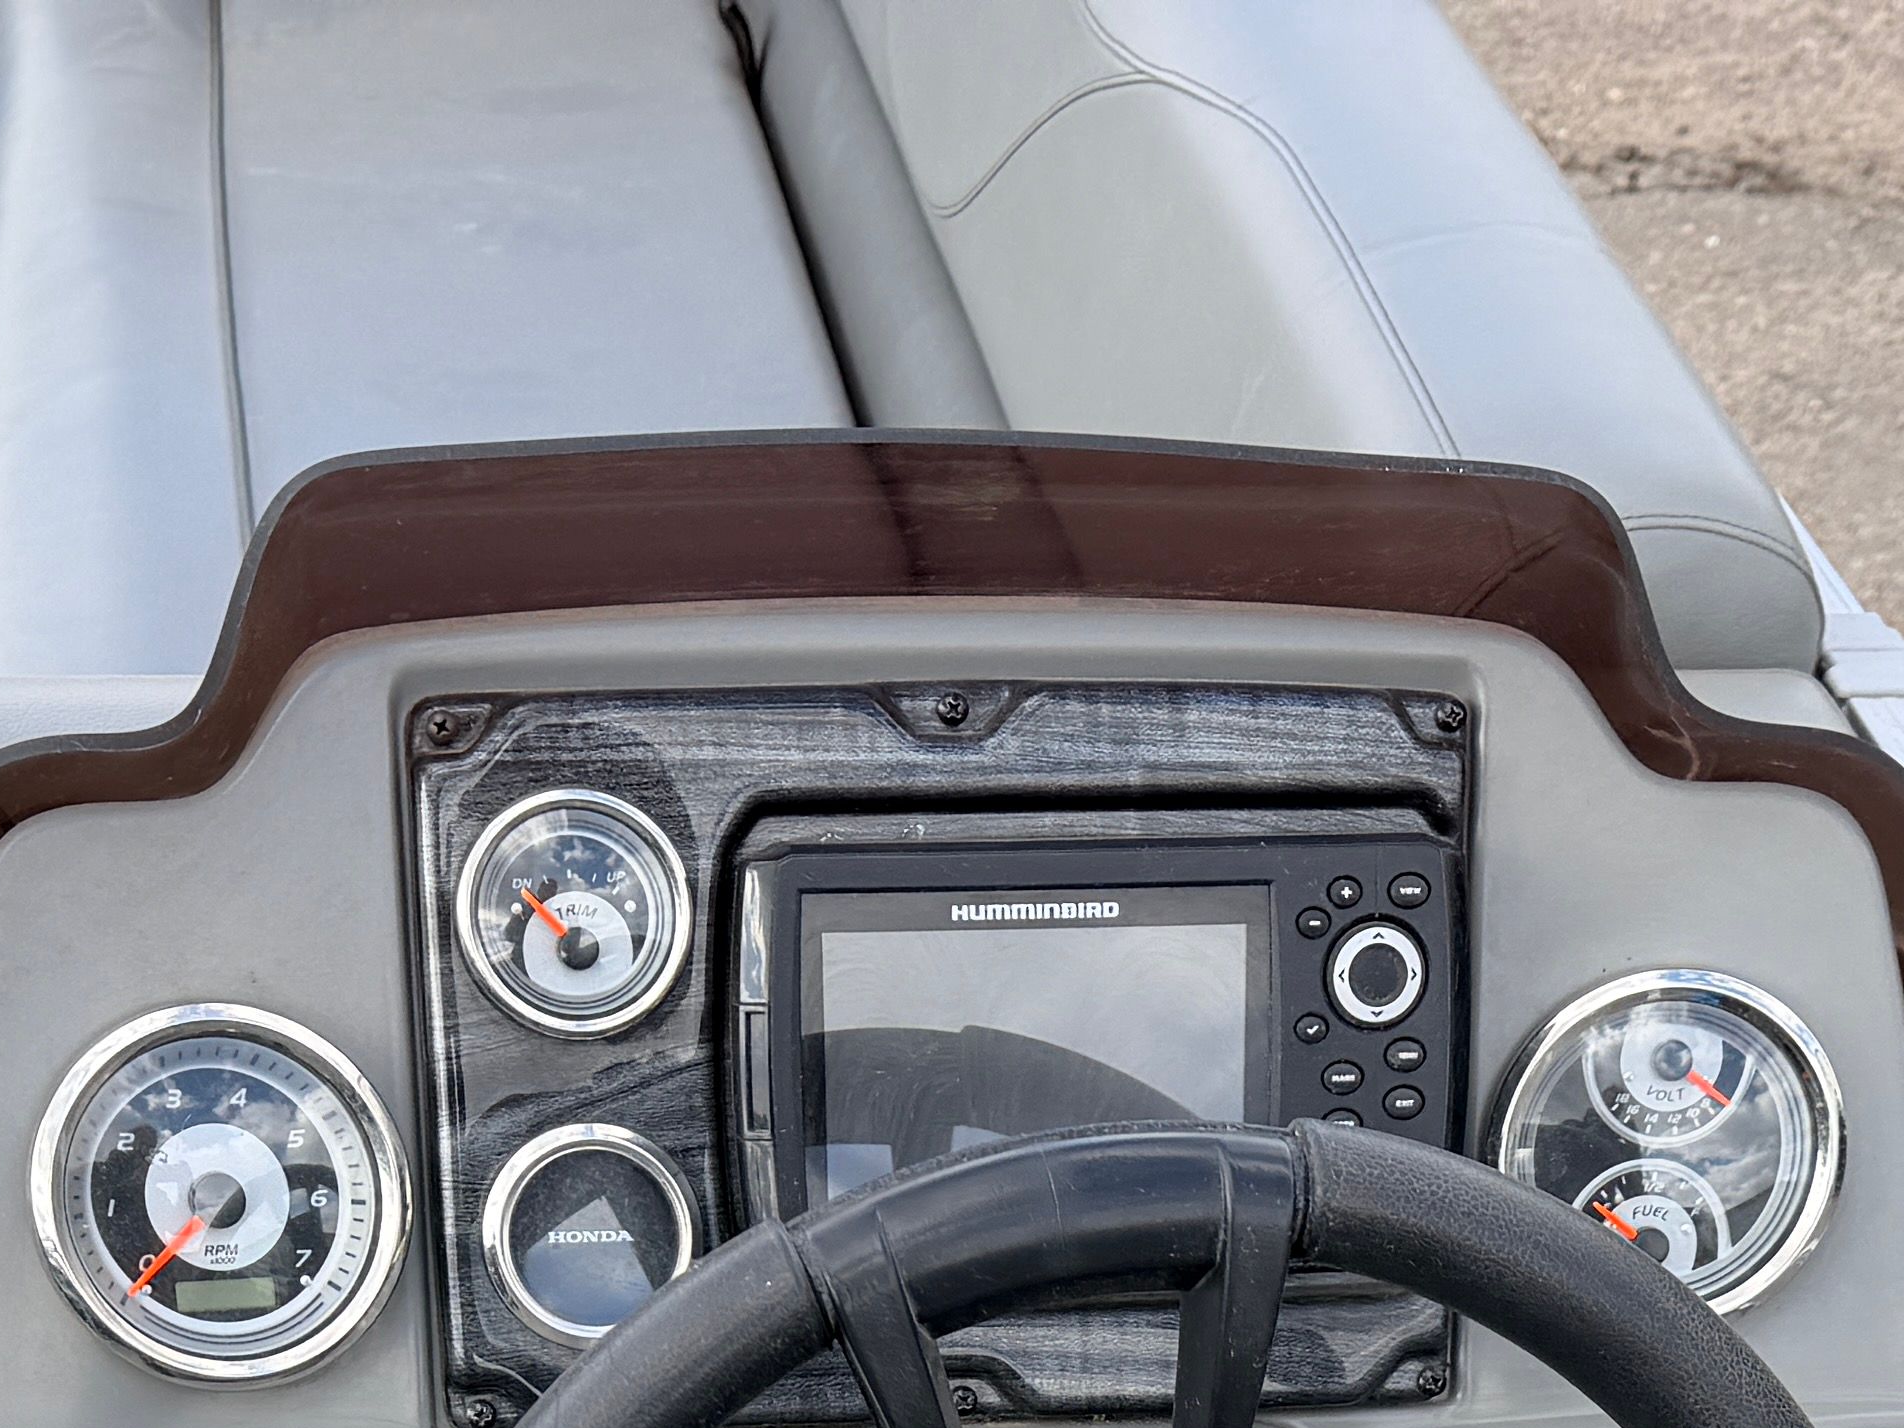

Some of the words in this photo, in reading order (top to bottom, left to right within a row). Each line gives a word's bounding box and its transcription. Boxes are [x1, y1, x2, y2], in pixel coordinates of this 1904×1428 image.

[512, 878, 532, 889] DN
[555, 904, 599, 919] TRIM
[951, 902, 1120, 921] HUMMINBIRD
[166, 1089, 182, 1109] 3
[229, 1088, 247, 1108] 4
[1646, 1085, 1685, 1102] VOLT
[1643, 1113, 1659, 1123] 14
[1667, 1113, 1682, 1124] 12
[117, 1133, 135, 1151] 2
[287, 1129, 306, 1148] 5
[310, 1189, 328, 1207] 6
[107, 1199, 115, 1217] 1
[1632, 1204, 1669, 1221] FUEL
[548, 1230, 635, 1243] HONDA
[204, 1244, 238, 1256] RPM
[295, 1249, 312, 1268] 7
